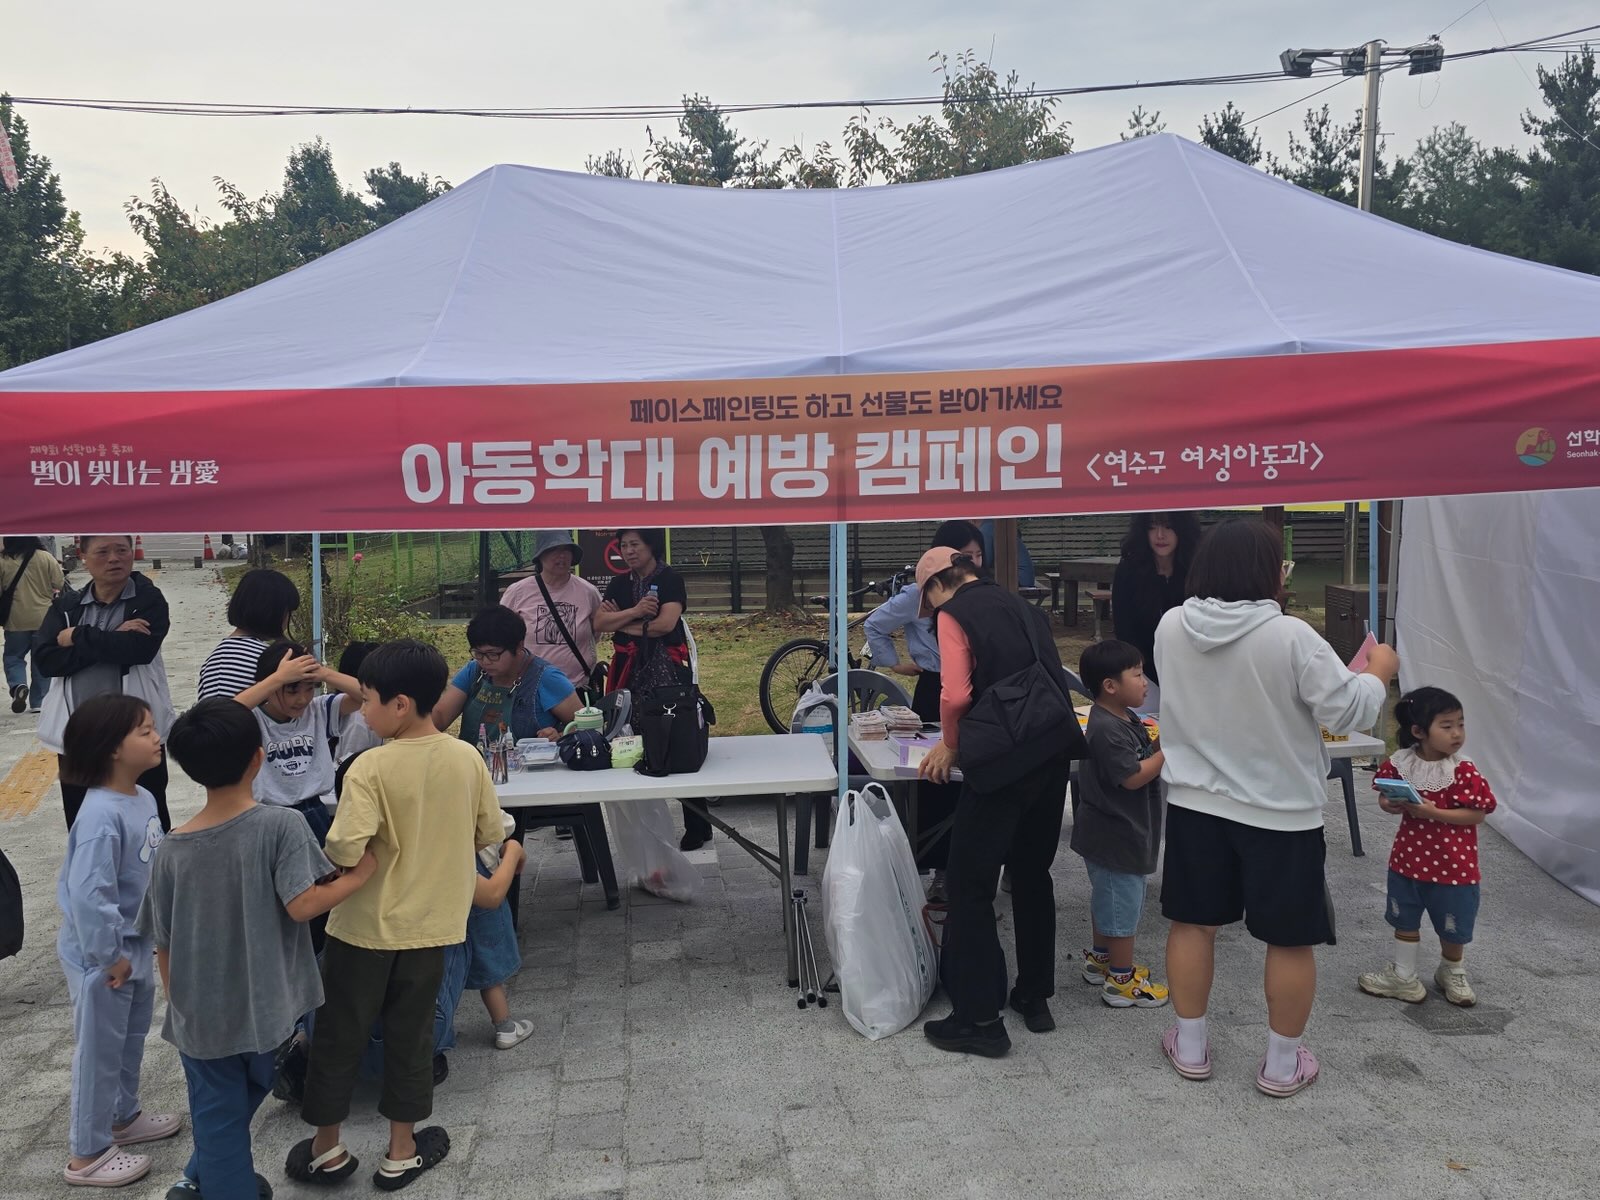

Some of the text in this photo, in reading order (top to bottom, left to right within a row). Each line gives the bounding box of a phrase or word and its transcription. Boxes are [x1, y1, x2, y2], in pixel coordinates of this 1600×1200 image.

[630, 384, 1063, 424] 페이스페인팅도 하고 선물도 받아가세요
[31, 460, 81, 486] 별이
[88, 460, 163, 486] 빛나는
[401, 423, 1063, 505] 아동학대 예방 캠페인
